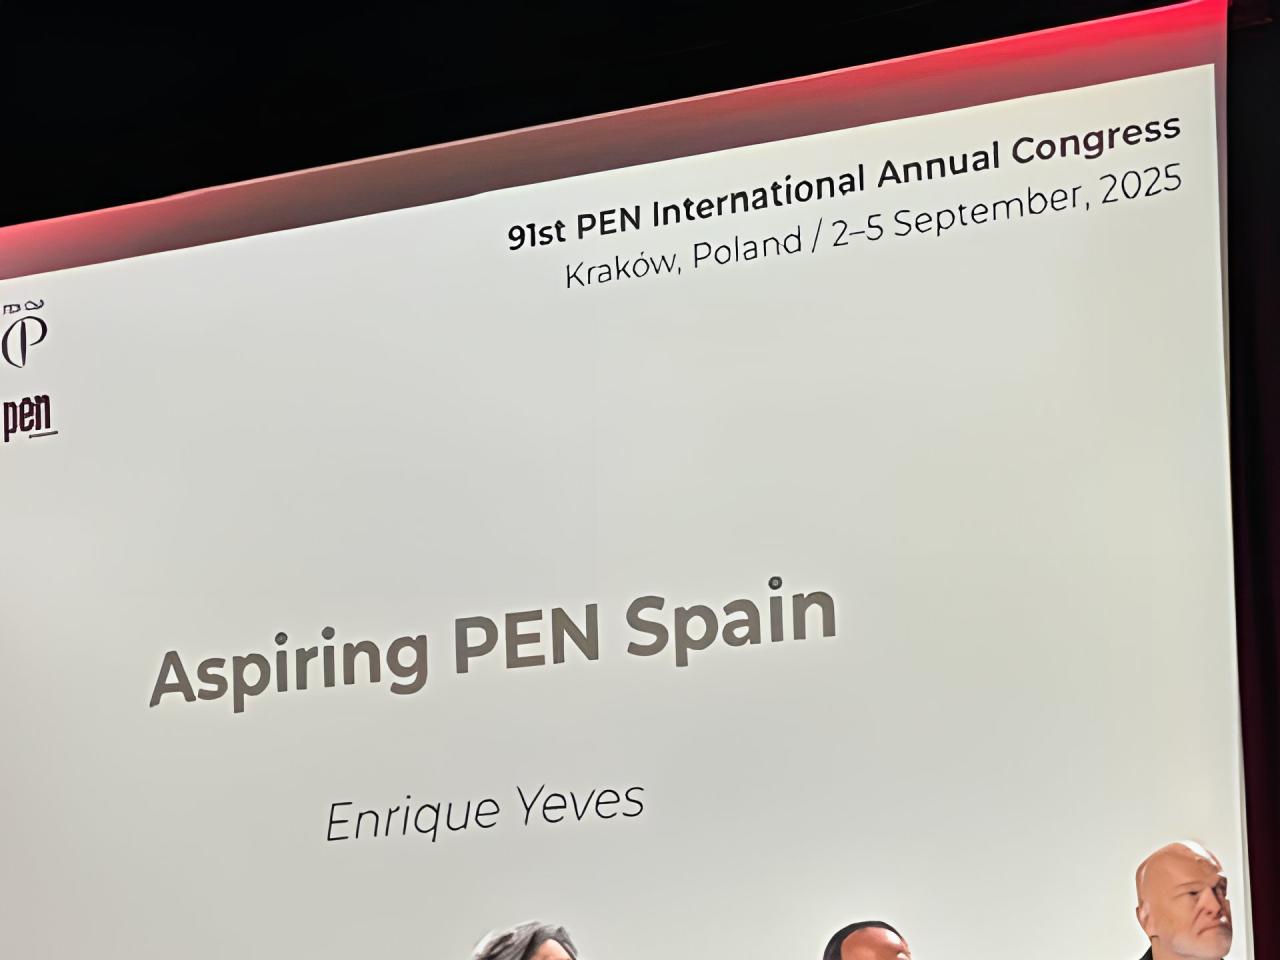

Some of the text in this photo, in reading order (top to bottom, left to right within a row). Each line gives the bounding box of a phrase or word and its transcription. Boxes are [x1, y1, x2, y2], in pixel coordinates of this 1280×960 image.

[507, 117, 1182, 251] 91st PEN International Annual Congress
[565, 250, 682, 289] Kraków,
[693, 224, 802, 269] Poland
[811, 216, 823, 254] /
[893, 186, 1090, 238] September,
[1099, 162, 1182, 205] 2025
[3, 394, 51, 443] pen
[149, 575, 836, 714] Aspiring PEN Spain
[326, 783, 645, 843] Enrique Yeves
